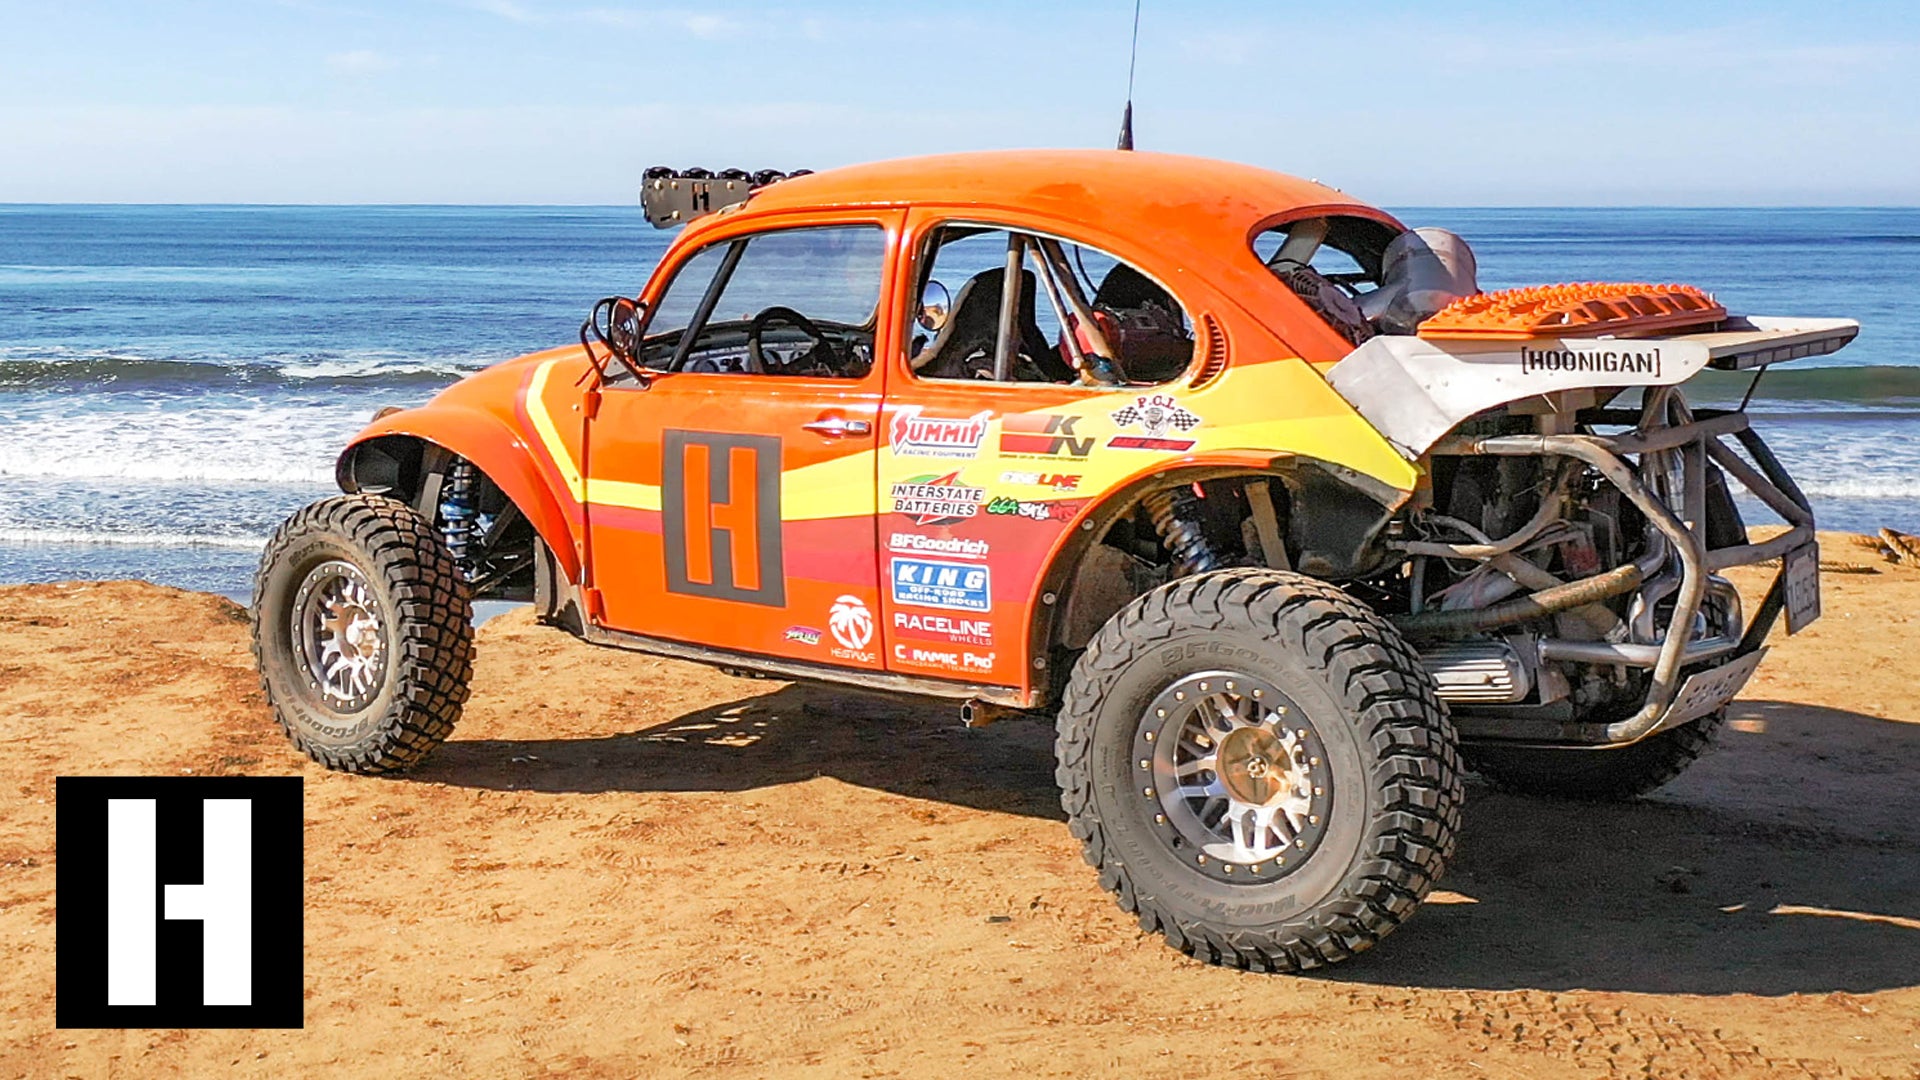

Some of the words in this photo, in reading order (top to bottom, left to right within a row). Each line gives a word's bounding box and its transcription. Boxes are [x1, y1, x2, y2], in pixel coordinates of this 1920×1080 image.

[895, 413, 980, 444] SUMMIT
[891, 485, 982, 501] INTERSTATE
[894, 500, 976, 516] BATTERIES
[890, 533, 989, 554] BFGoodrich
[897, 564, 985, 589] KING
[898, 592, 939, 602] RACING
[942, 597, 984, 607] SHOCKS
[909, 586, 966, 597] OFF-ROAD
[894, 613, 991, 637] RACELINE
[949, 634, 992, 646] WHEELS
[894, 644, 958, 666] CRAMIC
